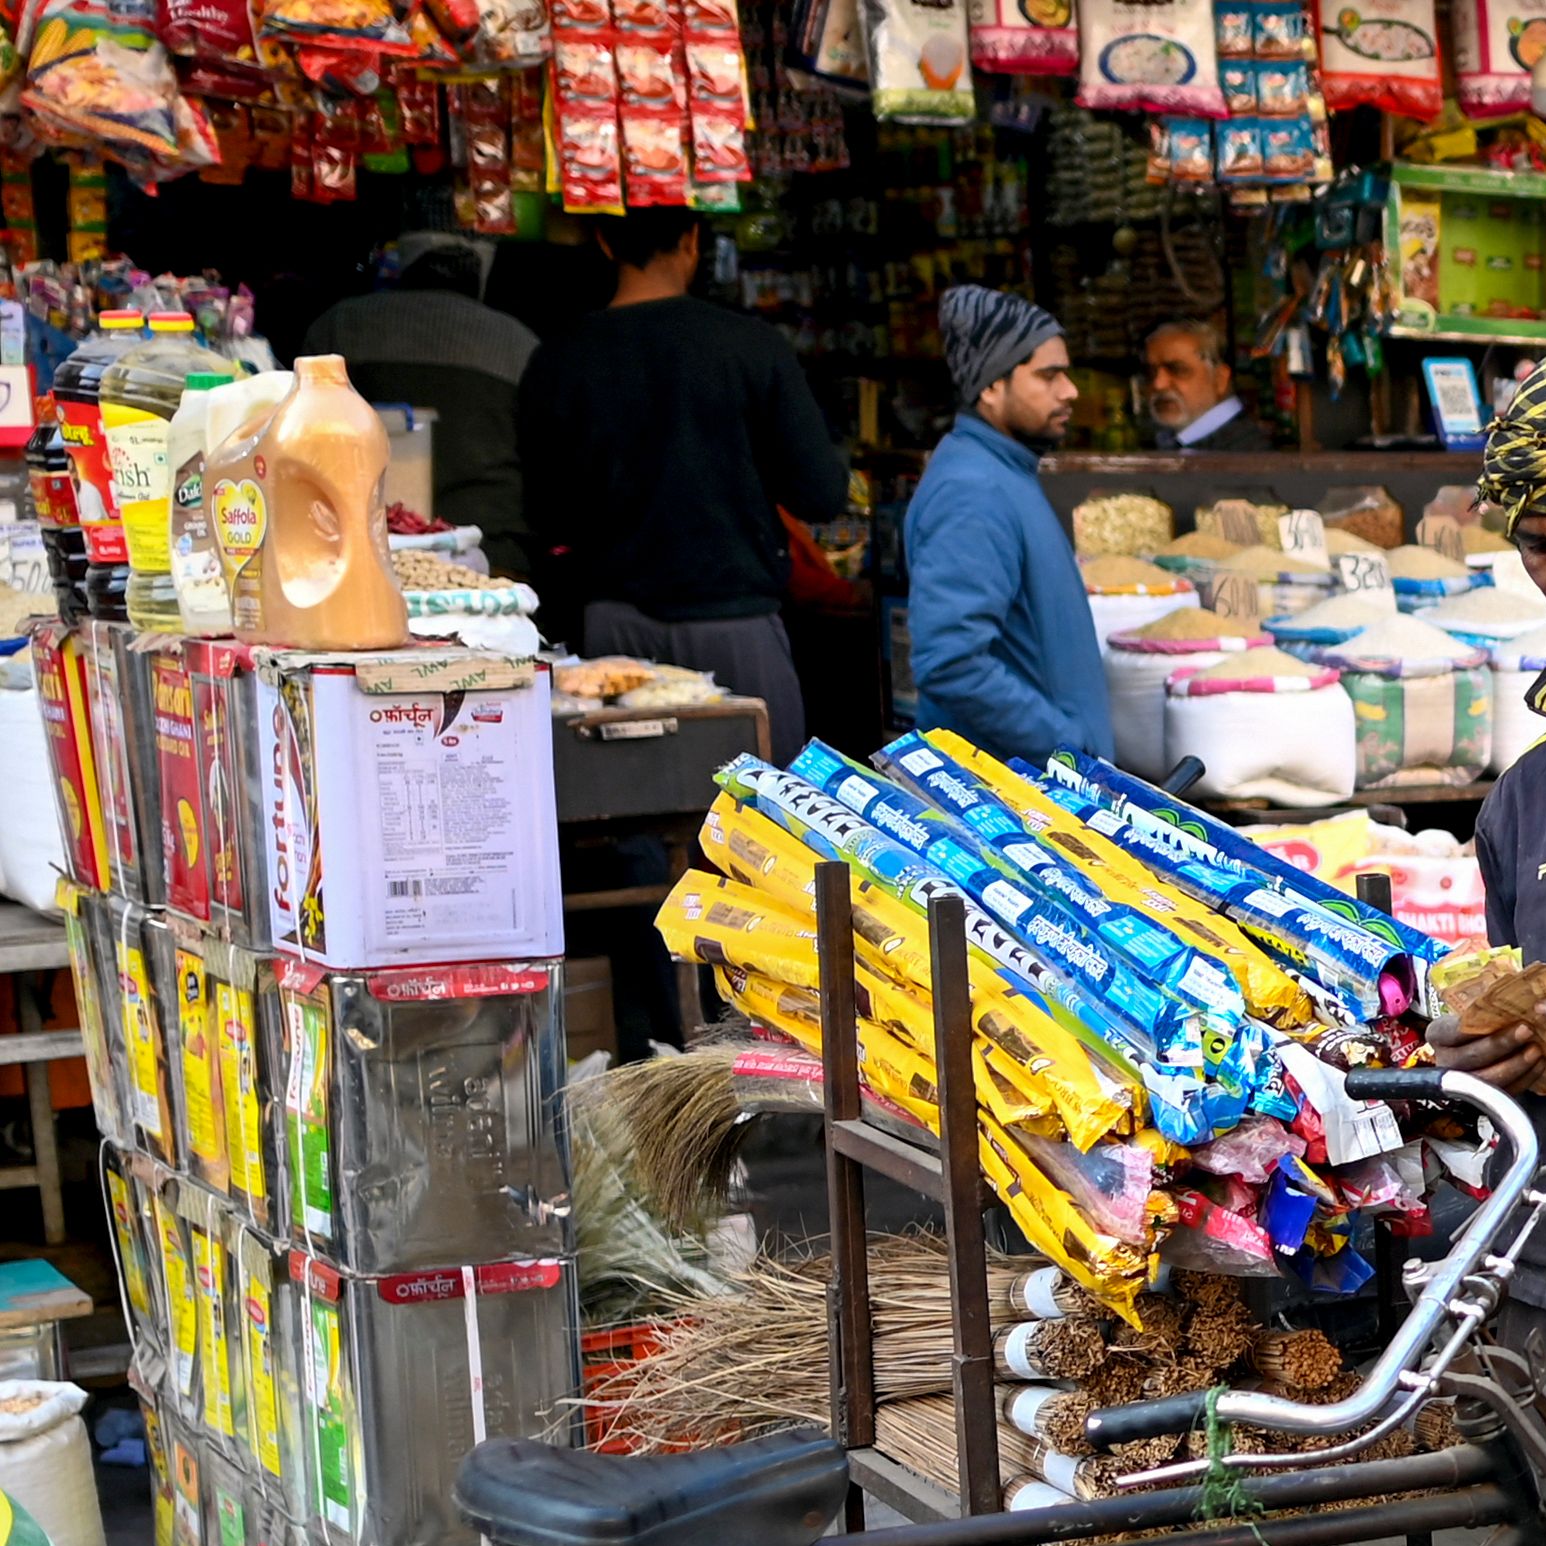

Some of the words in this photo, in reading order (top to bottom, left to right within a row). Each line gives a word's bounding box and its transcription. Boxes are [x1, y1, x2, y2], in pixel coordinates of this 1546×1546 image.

[221, 507, 257, 526] Saffola
[227, 531, 252, 544] GOLD
[1344, 554, 1385, 592] 320
[411, 658, 448, 679] AWL
[449, 669, 488, 690] AWL
